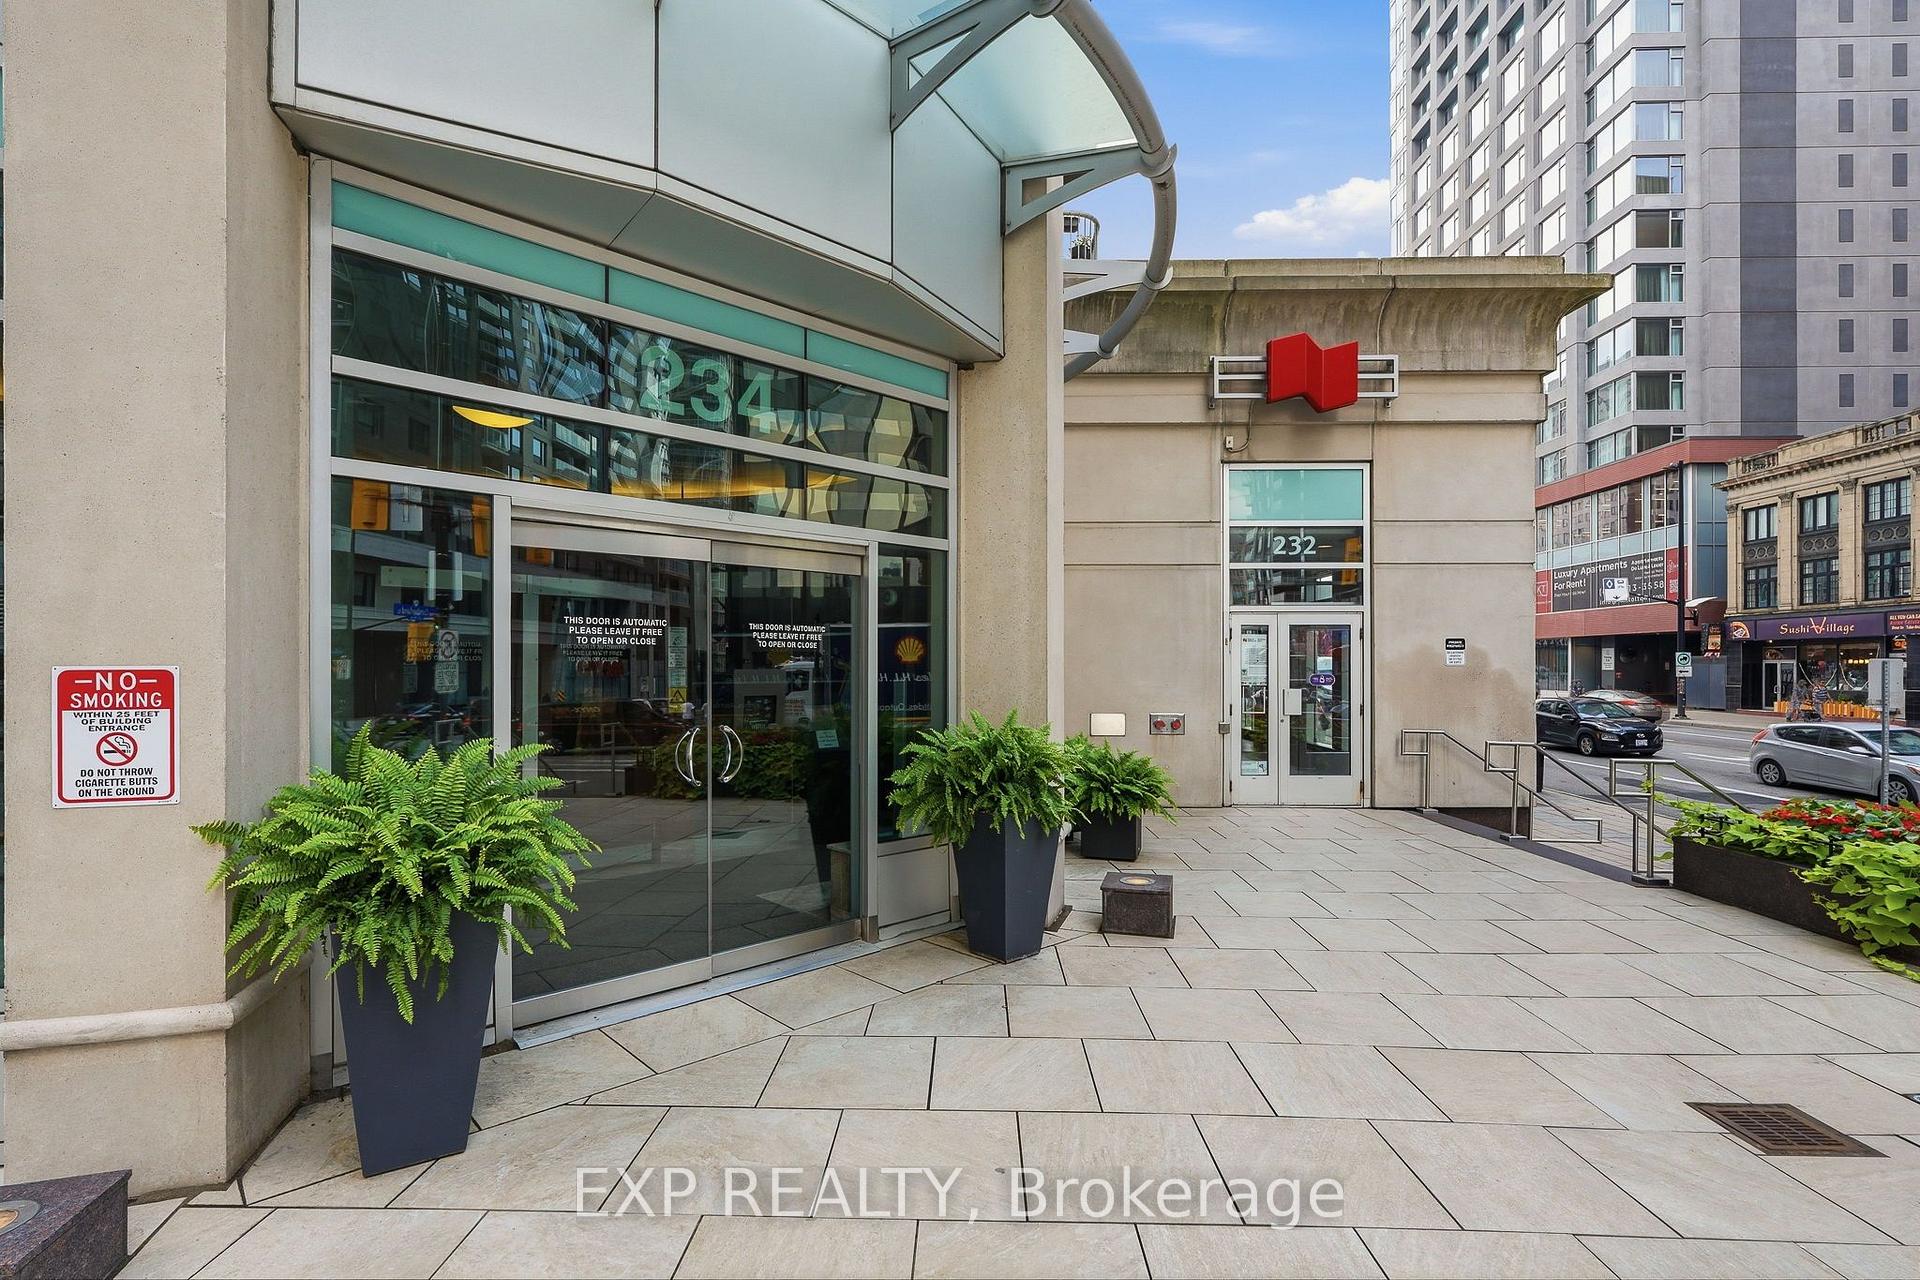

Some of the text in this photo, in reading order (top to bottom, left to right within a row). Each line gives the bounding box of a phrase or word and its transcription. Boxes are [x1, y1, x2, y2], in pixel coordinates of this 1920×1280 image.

[639, 346, 776, 434] 234
[1273, 535, 1317, 555] 232
[1554, 569, 1578, 579] Luxury
[1581, 560, 1627, 576] Apartments
[1554, 578, 1586, 591] For Rent!
[564, 616, 668, 627] THIS DOOR IS AUTOMATIC
[1780, 616, 1855, 635] Sushi Village
[569, 626, 663, 636] PLEASE LEAVE IT FREE
[749, 622, 826, 633] THIS DOOR IS AUTOMATIC
[576, 636, 657, 646] TO OPEN OR CLOSE
[752, 631, 778, 639] PLEASE
[778, 632, 799, 640] LEAVE
[806, 633, 823, 641] FREE
[758, 640, 767, 648] TO
[797, 641, 818, 649] CLOSE
[95, 672, 137, 691] NO
[70, 692, 162, 709] SMOKING
[99, 717, 152, 725] BUILDING
[88, 724, 146, 732] ENTRANCE
[80, 767, 153, 778] DO NOT THROW
[75, 776, 158, 788] CIGARETTE BUTTS
[78, 786, 155, 798] ON THE GROUND
